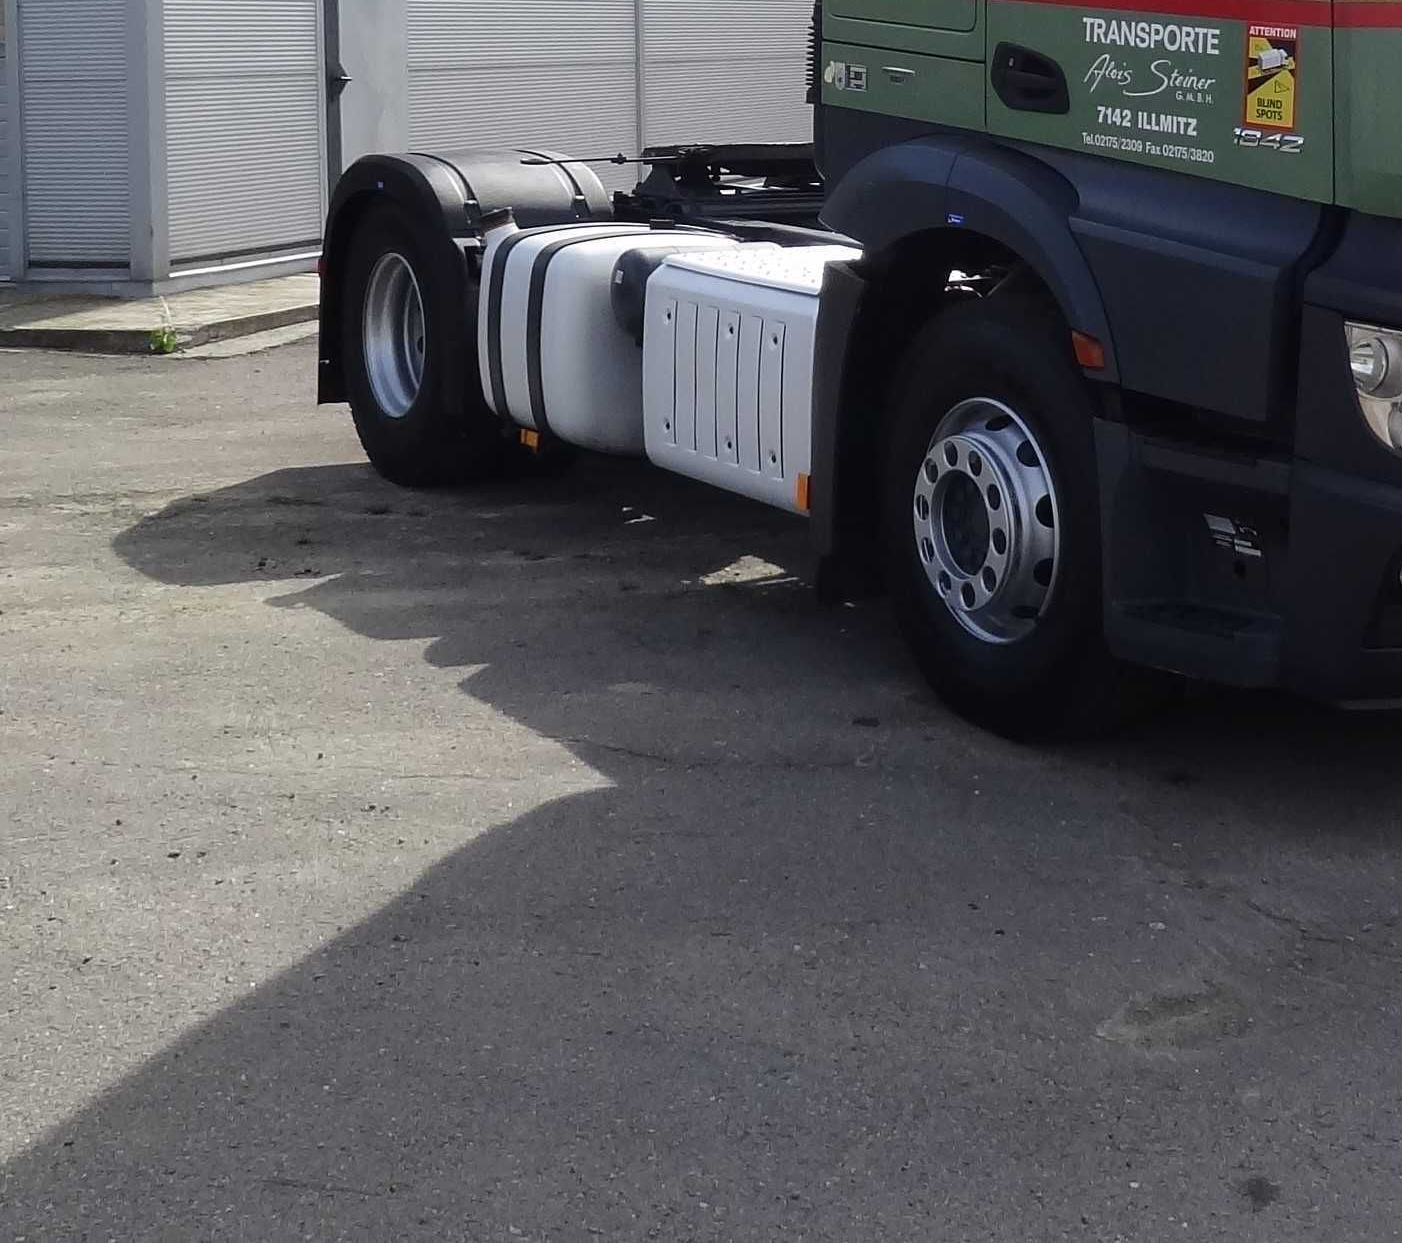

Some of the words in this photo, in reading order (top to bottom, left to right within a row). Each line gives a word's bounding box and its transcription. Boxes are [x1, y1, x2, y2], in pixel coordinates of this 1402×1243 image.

[1083, 17, 1220, 55] TRANSPORTE
[1249, 26, 1297, 39] ATTENTION
[1084, 54, 1133, 93] Alois
[1122, 60, 1216, 96] Steiner
[1257, 97, 1283, 109] BLIND
[1097, 106, 1132, 128] 7142
[1138, 111, 1198, 136] ILLMITZ
[1256, 109, 1283, 121] SPOTS
[1145, 142, 1161, 156] Fax
[1233, 127, 1305, 153] 1942
